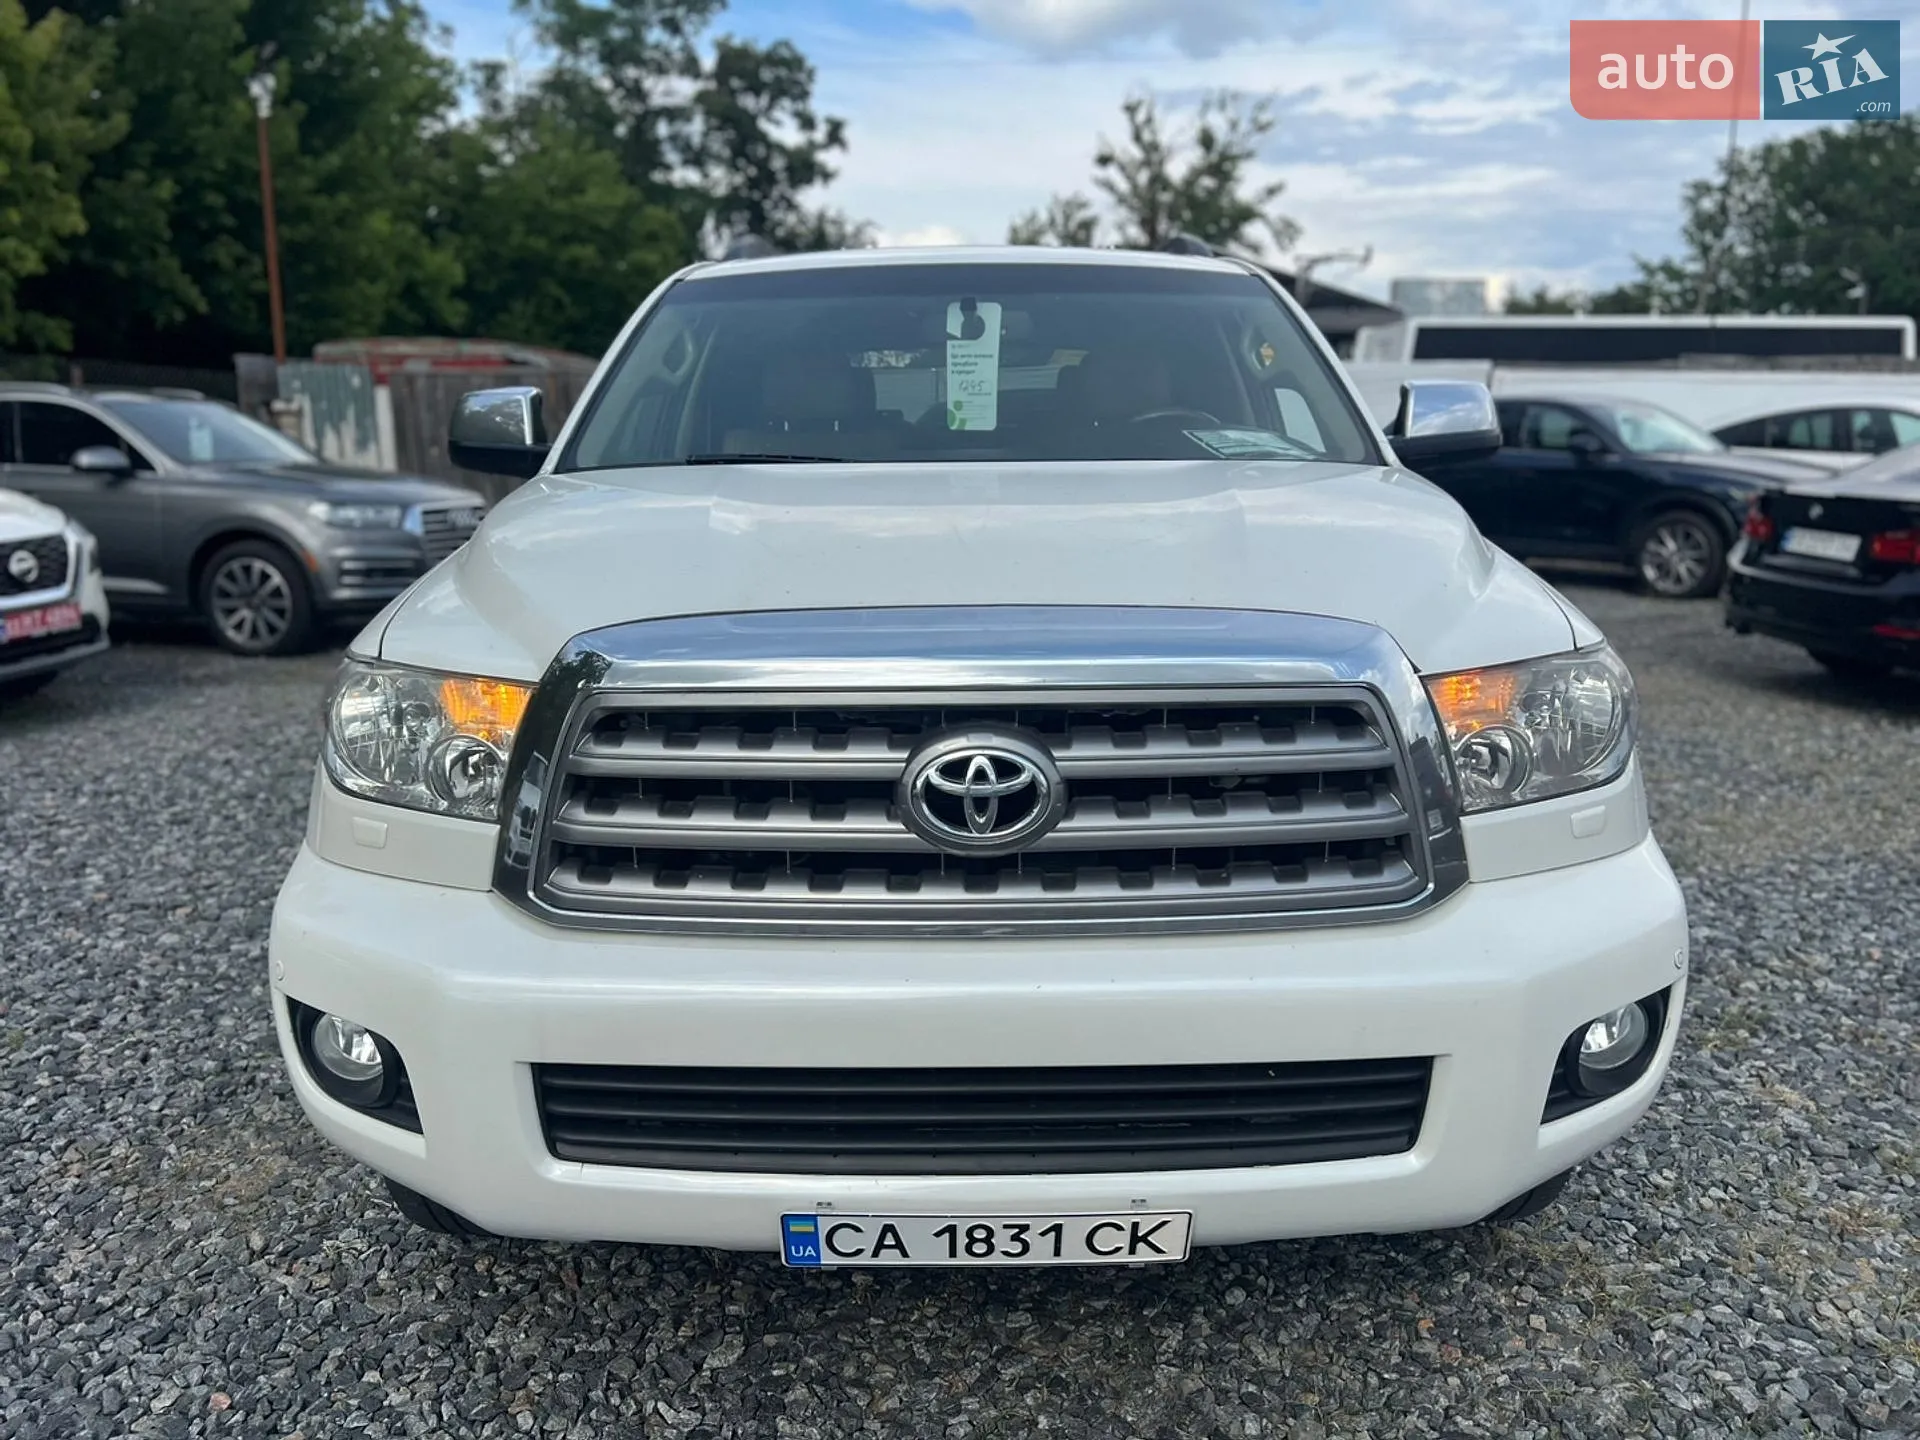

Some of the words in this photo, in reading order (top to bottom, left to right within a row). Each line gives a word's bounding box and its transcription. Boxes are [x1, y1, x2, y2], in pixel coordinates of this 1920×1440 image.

[791, 1245, 817, 1257] UA
[825, 1222, 911, 1259] CA
[932, 1221, 1065, 1259] 1831
[1085, 1219, 1172, 1257] CK
